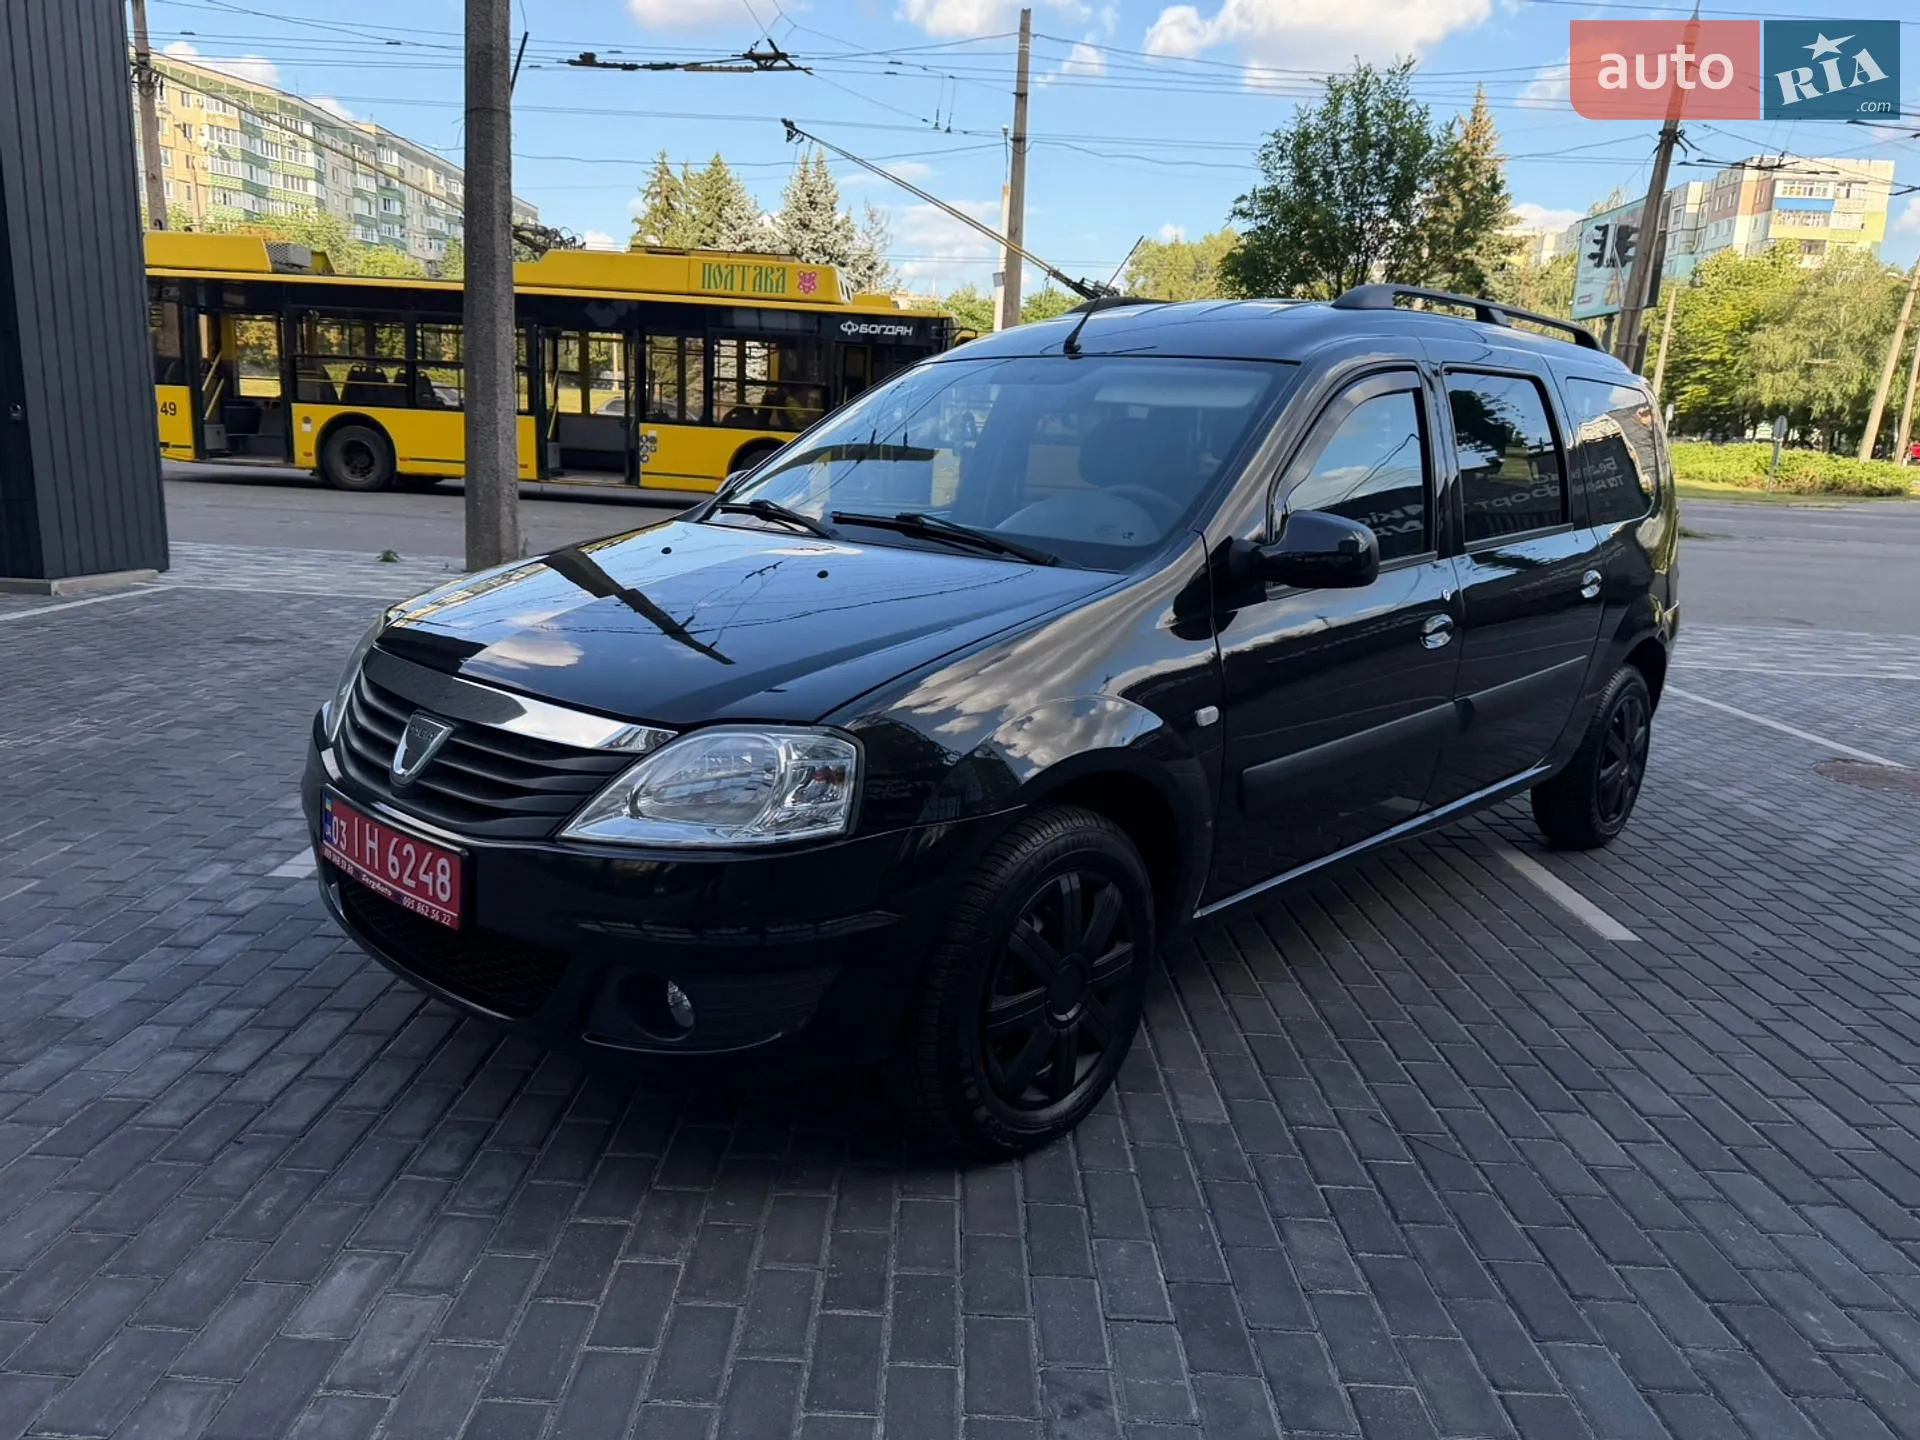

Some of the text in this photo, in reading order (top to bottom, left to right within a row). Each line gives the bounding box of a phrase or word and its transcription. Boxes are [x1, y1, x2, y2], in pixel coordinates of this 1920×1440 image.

[702, 263, 788, 294] ПОЛТАВА
[858, 323, 913, 337] БОГДАН
[160, 402, 177, 416] 49
[332, 815, 347, 851] 03
[388, 837, 451, 903] 6248
